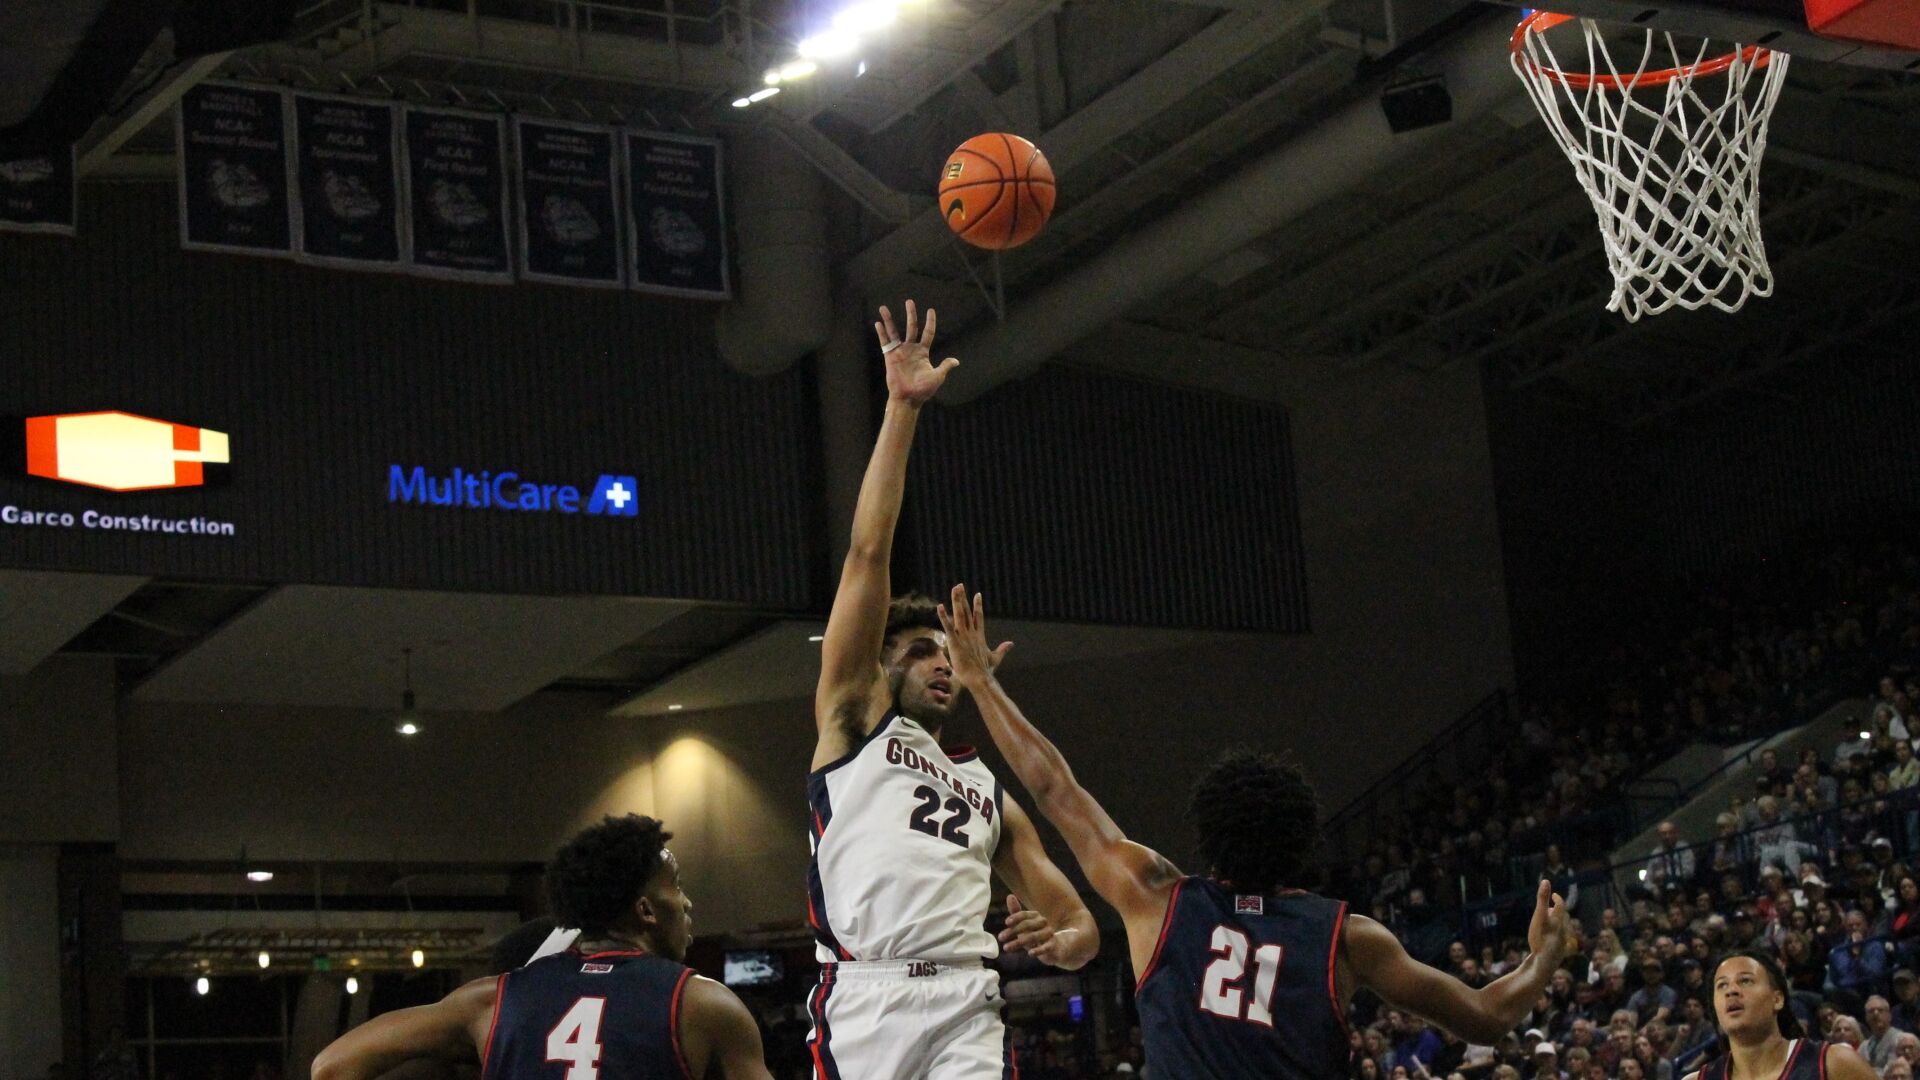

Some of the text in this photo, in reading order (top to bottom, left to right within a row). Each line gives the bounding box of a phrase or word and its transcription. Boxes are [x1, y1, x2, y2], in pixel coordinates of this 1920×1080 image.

[327, 132, 365, 146] NCAA
[436, 146, 473, 160] NCAA
[548, 158, 586, 171] NCAA
[389, 464, 580, 514] MultiCare
[1, 505, 235, 536] Garco Construction
[886, 737, 994, 826] GONZAGA
[910, 785, 972, 848] 22
[907, 962, 938, 978] ZAGS
[1198, 924, 1284, 1030] 21
[545, 995, 608, 1080] 4
